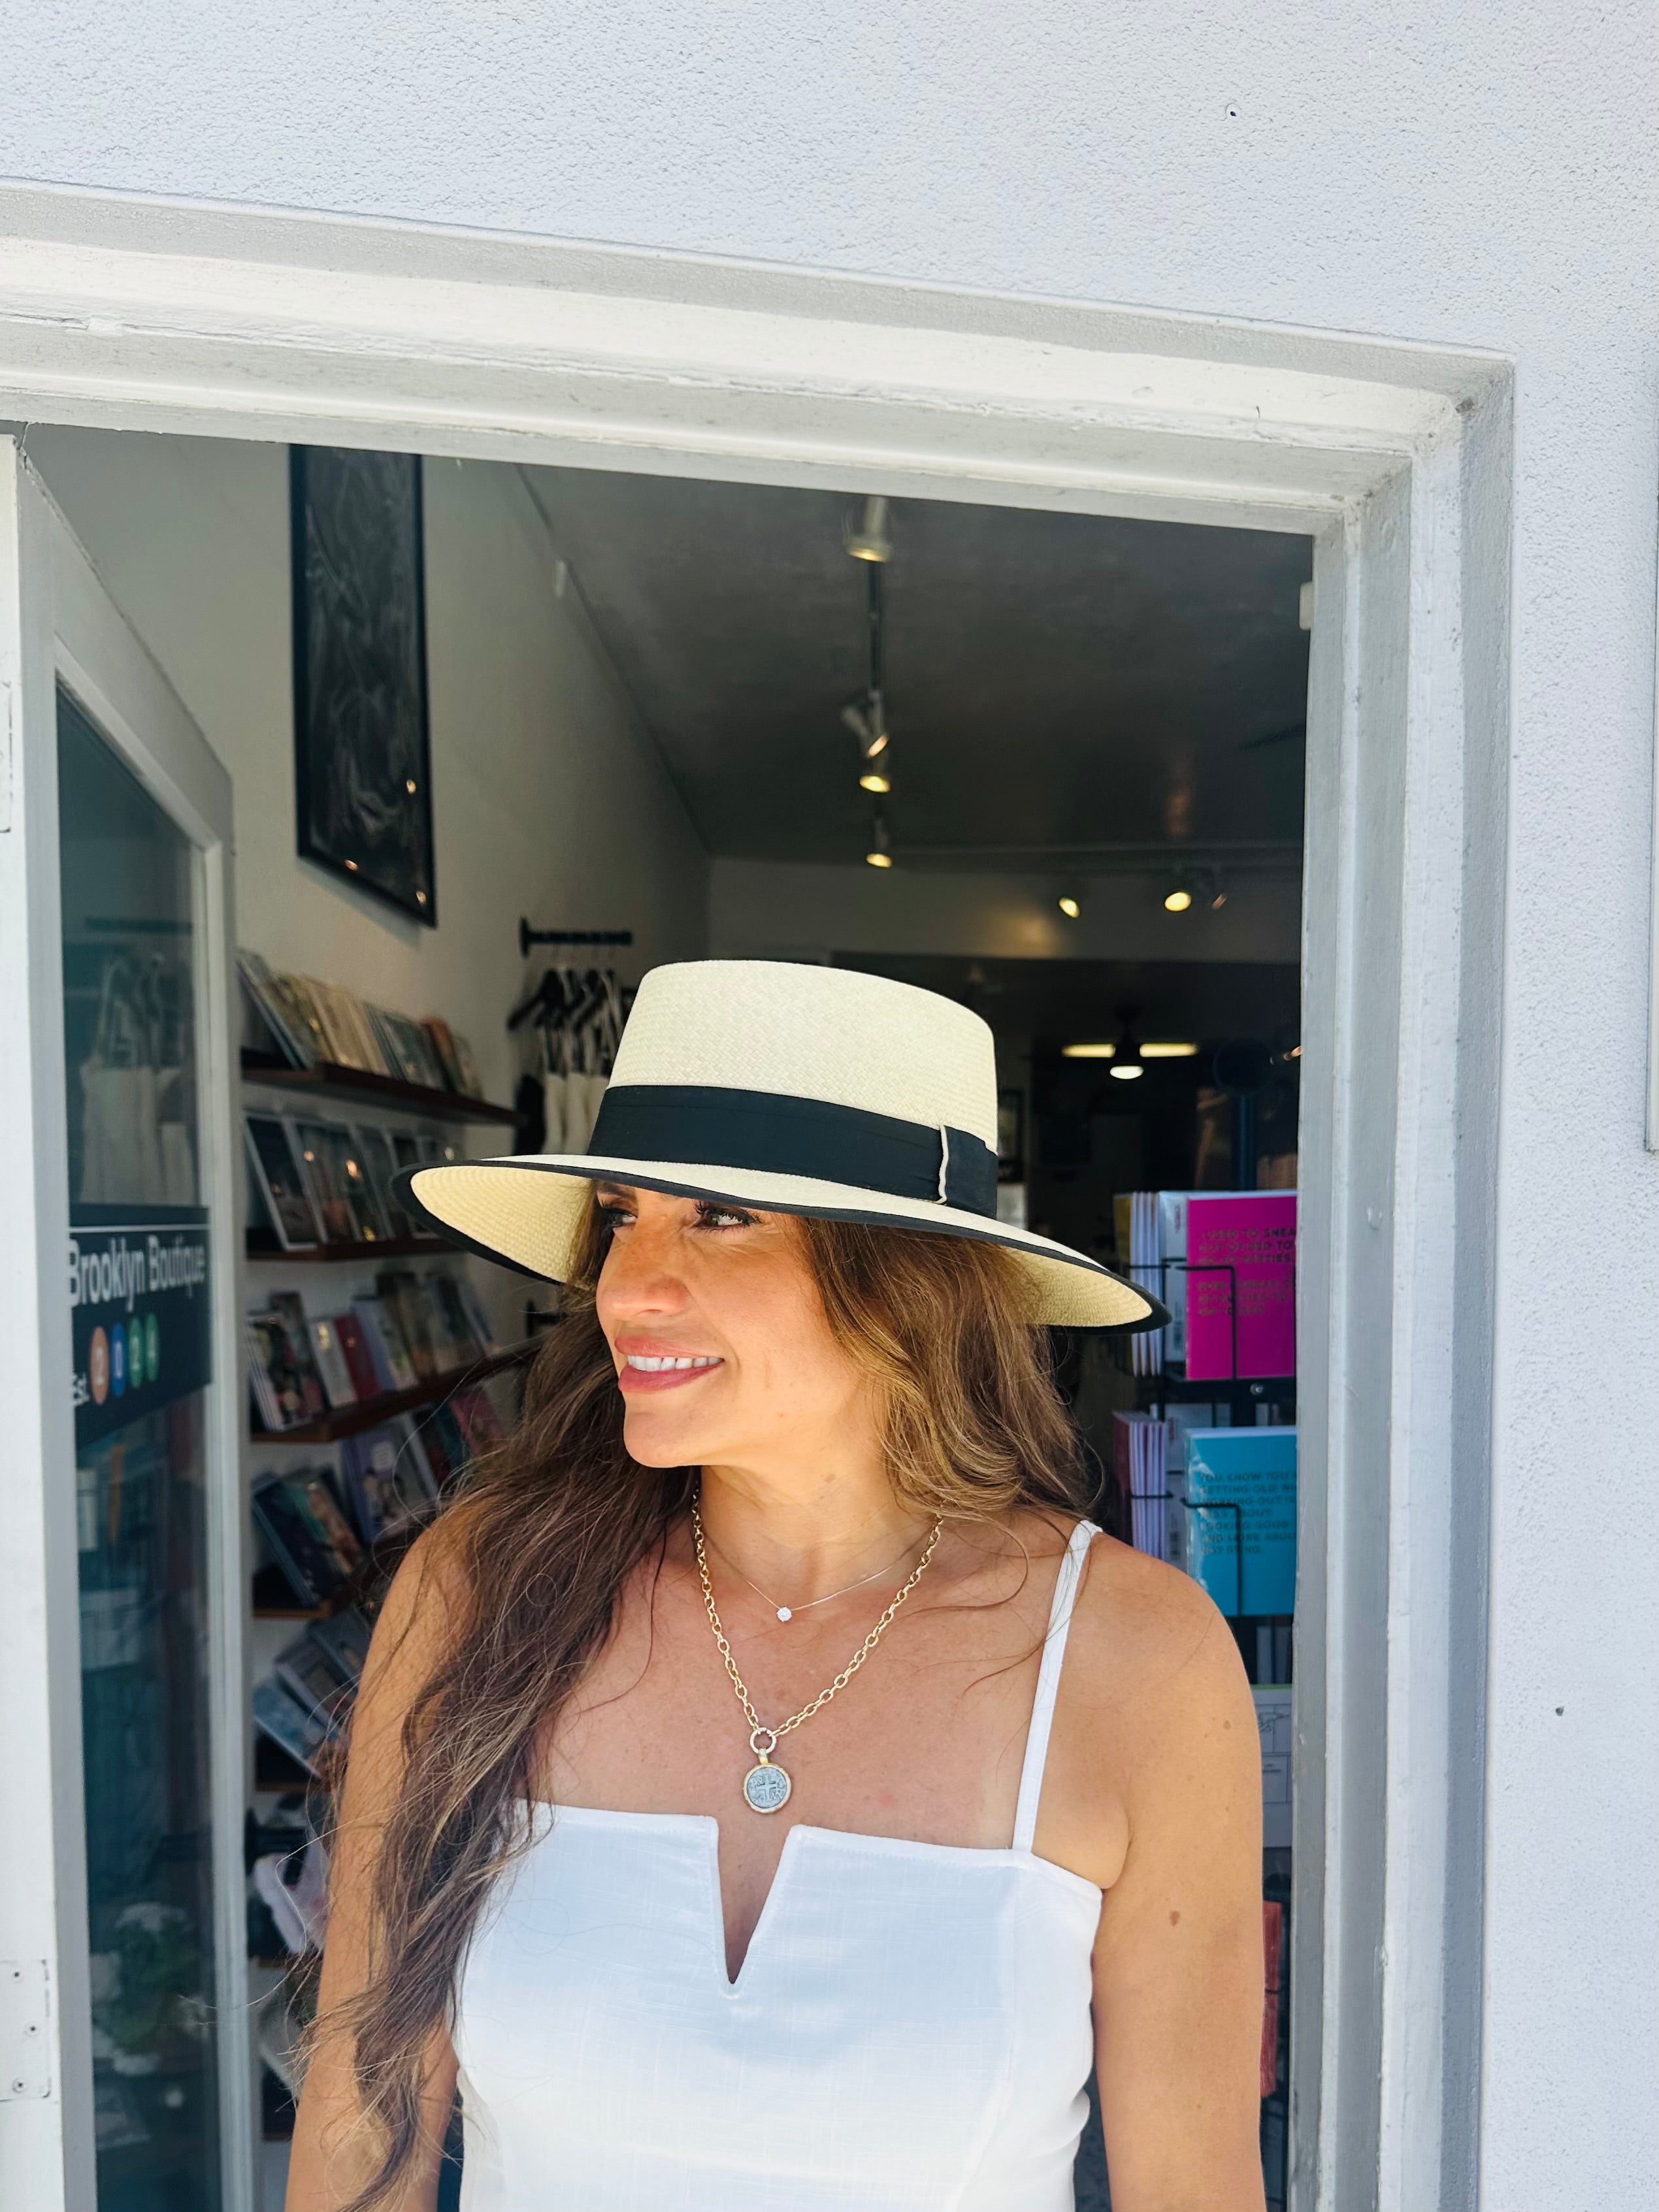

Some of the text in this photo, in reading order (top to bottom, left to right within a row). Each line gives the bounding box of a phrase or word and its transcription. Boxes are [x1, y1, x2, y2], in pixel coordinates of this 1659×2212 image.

[1243, 1228, 1258, 1237] TO
[1276, 1240, 1293, 1250] TO
[1241, 1253, 1291, 1263] PARTIES
[68, 1234, 205, 1312] Brooklyn Boutique
[1227, 1472, 1261, 1481] KNOW
[1253, 1484, 1276, 1493] OLD
[1257, 1495, 1281, 1505] OUT
[1255, 1520, 1289, 1529] GOOD
